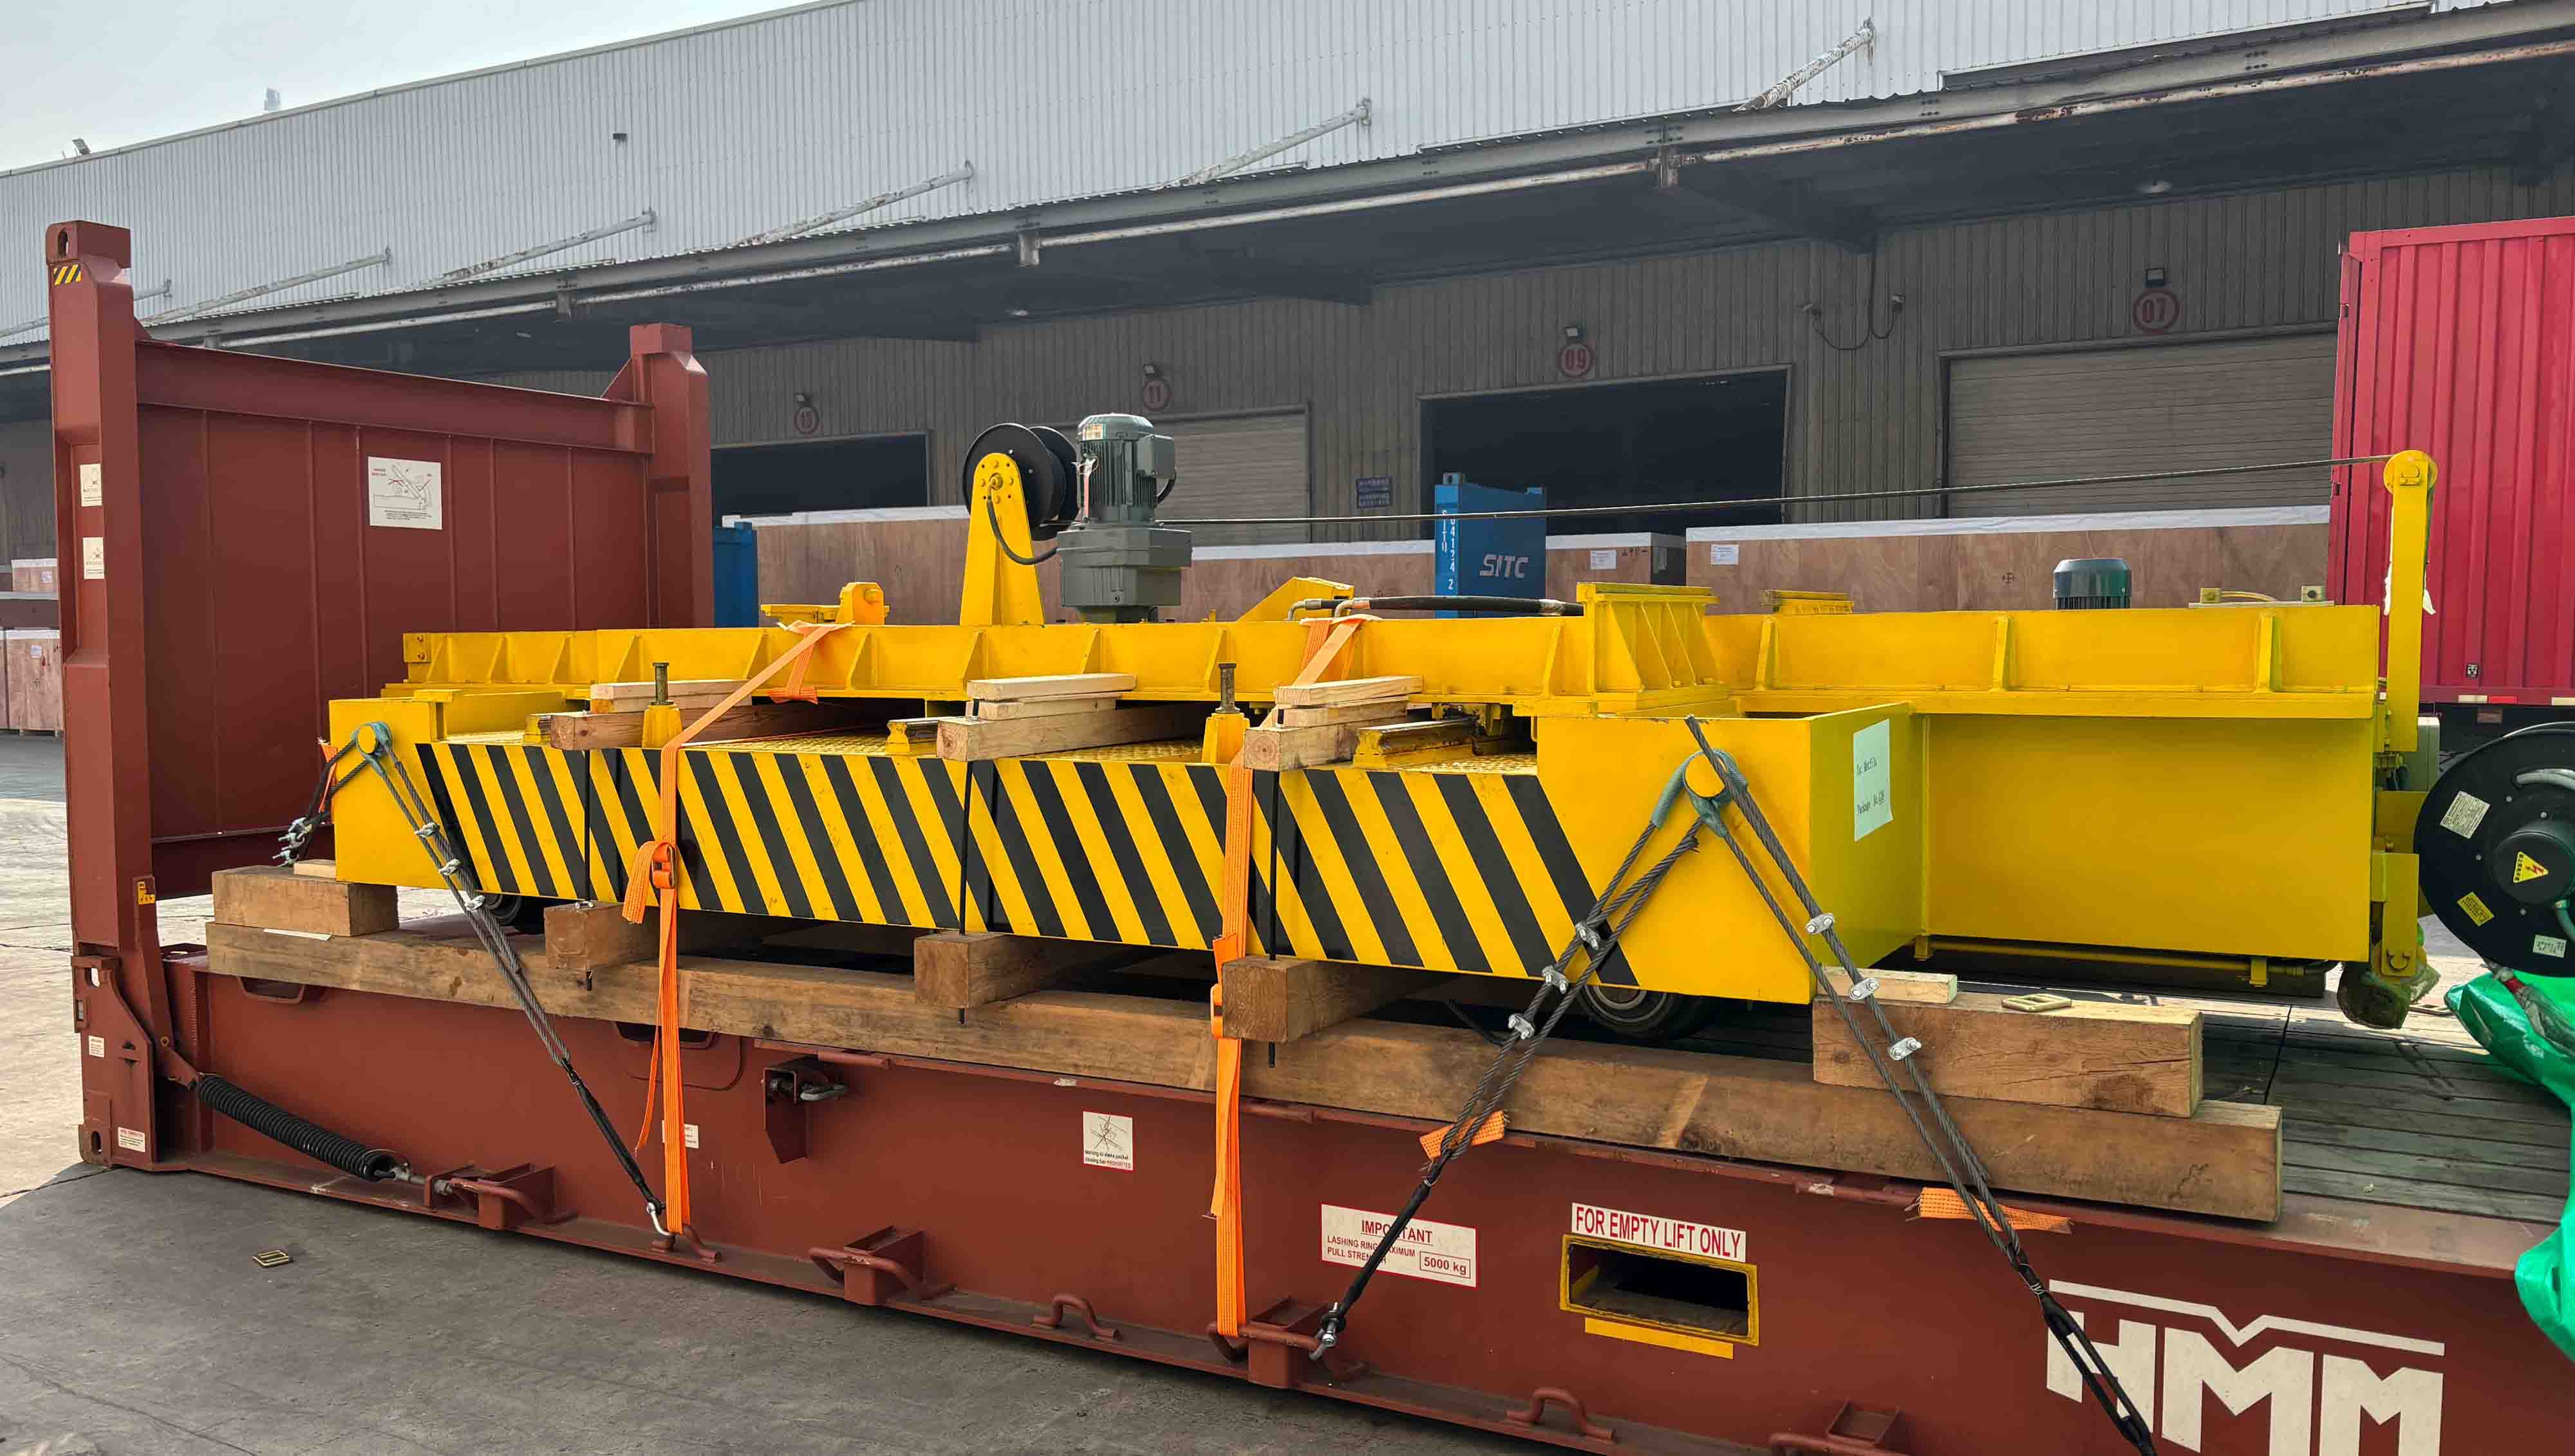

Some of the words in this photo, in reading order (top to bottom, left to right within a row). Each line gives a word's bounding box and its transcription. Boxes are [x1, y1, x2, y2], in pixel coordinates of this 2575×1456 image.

[2142, 299, 2164, 322] 07
[1566, 350, 1586, 371] 09
[1479, 554, 1529, 579] SITC
[1448, 578, 1453, 590] 2
[1327, 1235, 1359, 1247] LASHING
[1362, 1220, 1432, 1243] IMPOTANT
[1577, 1206, 1605, 1235] FOR
[1610, 1212, 1660, 1245] EMPTY
[1664, 1221, 1695, 1251] LIFT
[1700, 1227, 1741, 1258] ONLY
[1327, 1246, 1345, 1257] PULL
[1424, 1256, 1449, 1270] 5000
[1453, 1262, 1466, 1276] kg
[2046, 1309, 2444, 1456] HMM
